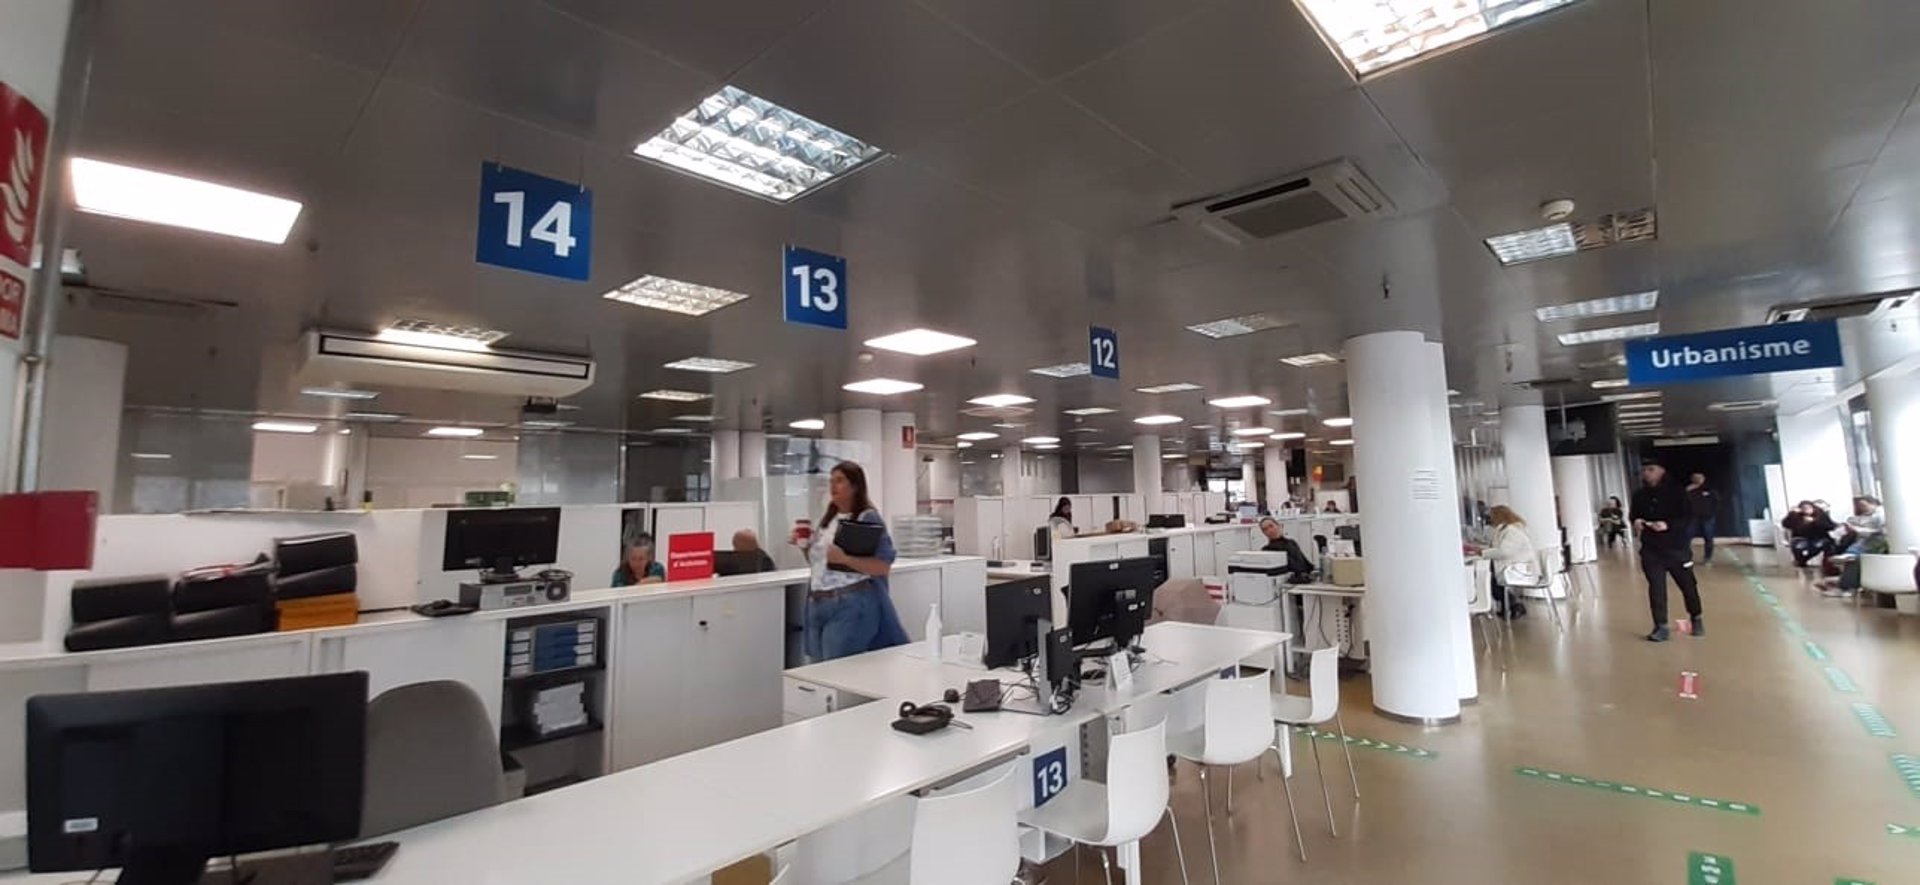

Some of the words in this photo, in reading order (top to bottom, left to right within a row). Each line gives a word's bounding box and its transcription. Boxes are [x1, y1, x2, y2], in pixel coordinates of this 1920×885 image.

[493, 190, 577, 257] 14
[792, 265, 839, 313] 13
[1092, 337, 1116, 369] 12
[1651, 338, 1811, 369] Urbanisme
[1037, 760, 1063, 798] 13
